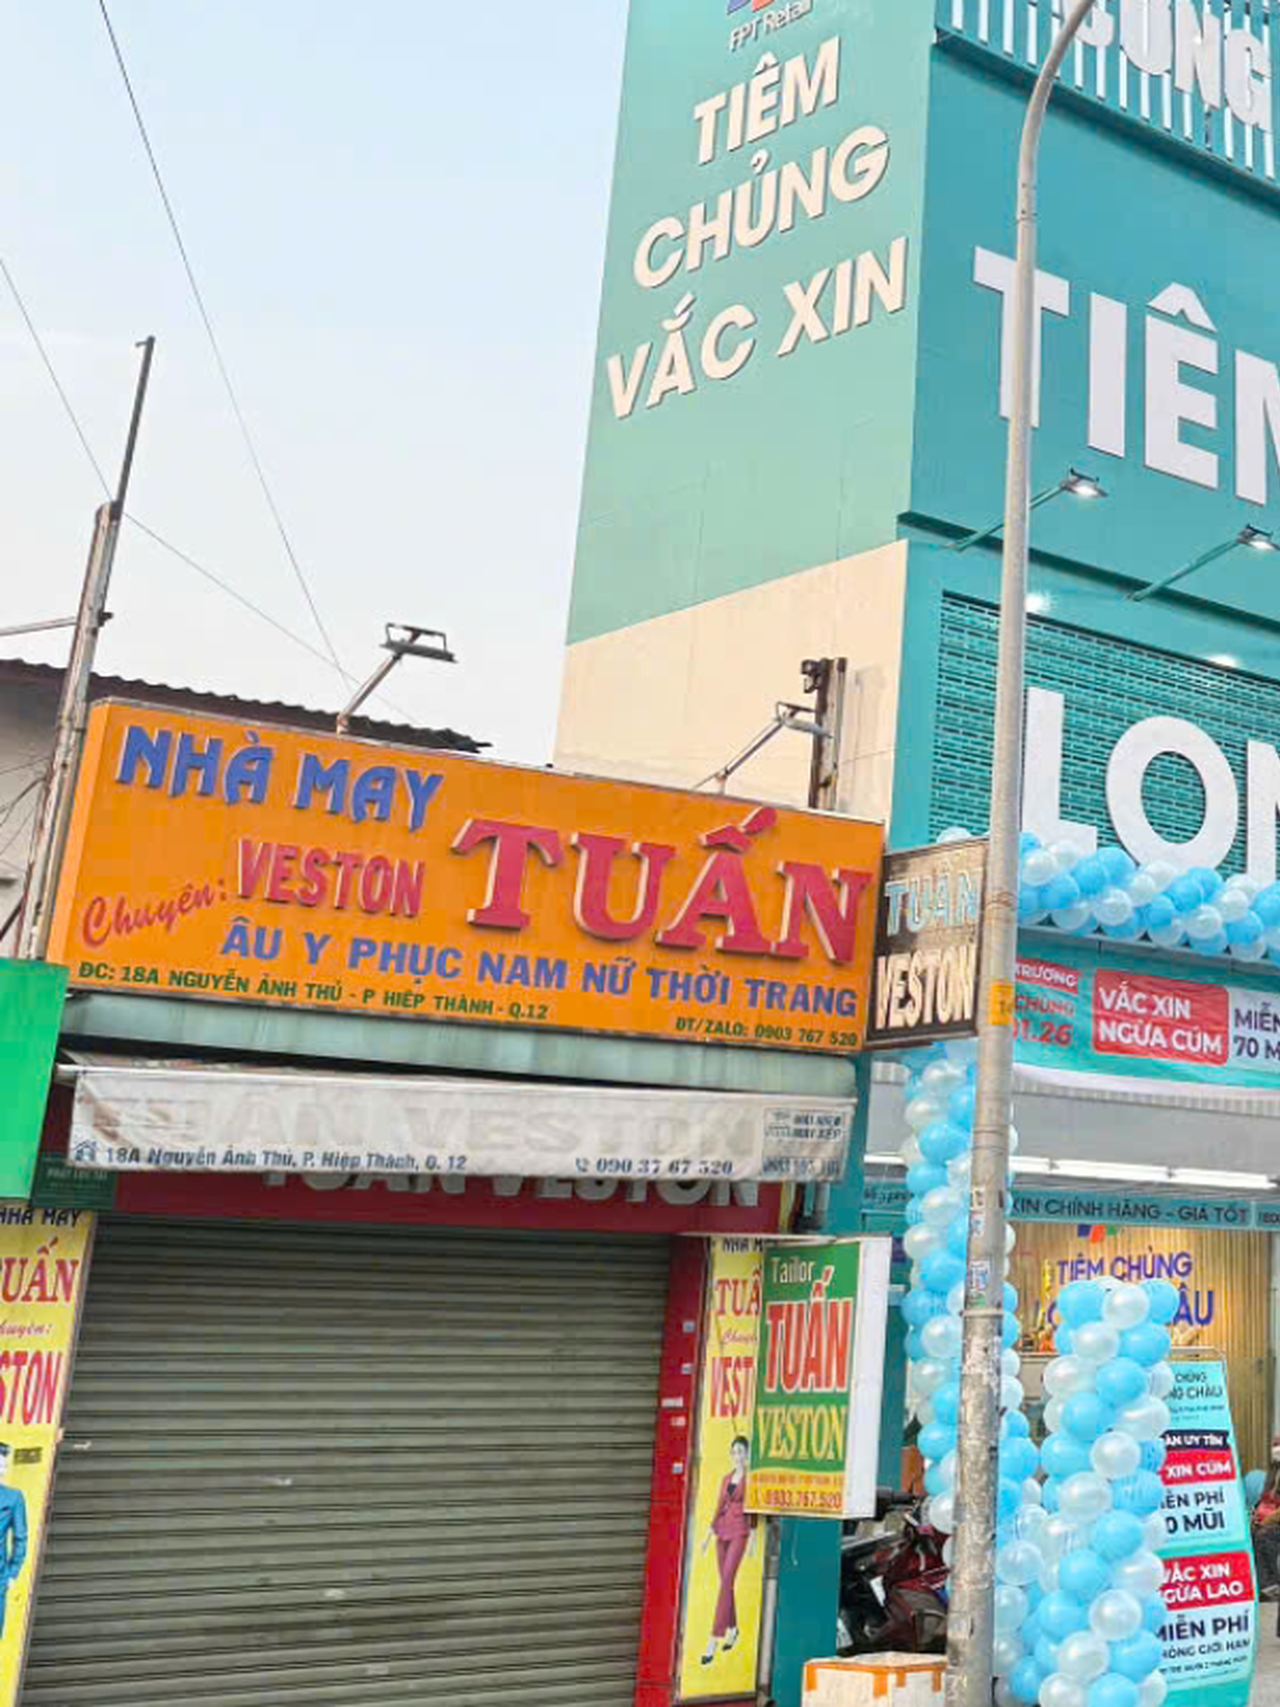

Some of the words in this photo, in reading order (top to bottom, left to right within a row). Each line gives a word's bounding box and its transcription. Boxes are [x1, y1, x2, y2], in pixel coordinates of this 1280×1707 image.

[730, 20, 758, 53] FPT
[693, 35, 841, 166] TIÊM
[633, 125, 891, 291] CHỦNG
[606, 293, 757, 420] VẮC
[777, 236, 909, 358] XIN
[116, 724, 275, 806] NHÀ
[293, 752, 445, 832] MAY
[83, 878, 228, 949] Chuyên:
[238, 838, 425, 918] VESTON
[450, 806, 875, 965] TUẤN
[221, 915, 283, 961] ÂU
[303, 932, 334, 966] Y
[347, 937, 464, 985] PHỤC
[477, 952, 568, 991] NAM
[582, 957, 637, 998] NỮ
[646, 965, 731, 1008] THỜI
[744, 977, 857, 1018] TRANG
[78, 961, 115, 982] ĐC:
[121, 965, 160, 987] 18A
[362, 989, 376, 1004] P
[508, 1000, 549, 1022] Q.12
[876, 943, 975, 1032] VESTON
[1099, 980, 1147, 1015] VẮC
[1151, 994, 1191, 1020] XIN
[755, 1025, 792, 1042] 0903
[798, 1028, 823, 1045] 767
[829, 1031, 858, 1048] 520
[1171, 1025, 1223, 1056] CÚM
[1233, 1035, 1260, 1059] 70
[105, 1148, 140, 1164] 18A
[447, 1155, 468, 1170] 12
[597, 1158, 632, 1174] 090
[638, 1158, 660, 1174] 37
[668, 1158, 691, 1175] 67
[1056, 1250, 1104, 1285] TIÊM
[1111, 1245, 1193, 1280] CHỦNG
[765, 1264, 853, 1393] TUẤN
[757, 1404, 848, 1461] VESTON
[1166, 1464, 1193, 1480] XIN
[1194, 1486, 1226, 1507] PHÍ
[1183, 1508, 1225, 1532] MŨI
[1200, 1562, 1231, 1580] XIN
[1207, 1580, 1245, 1600] LAO
[1212, 1608, 1250, 1636] PHÍ
